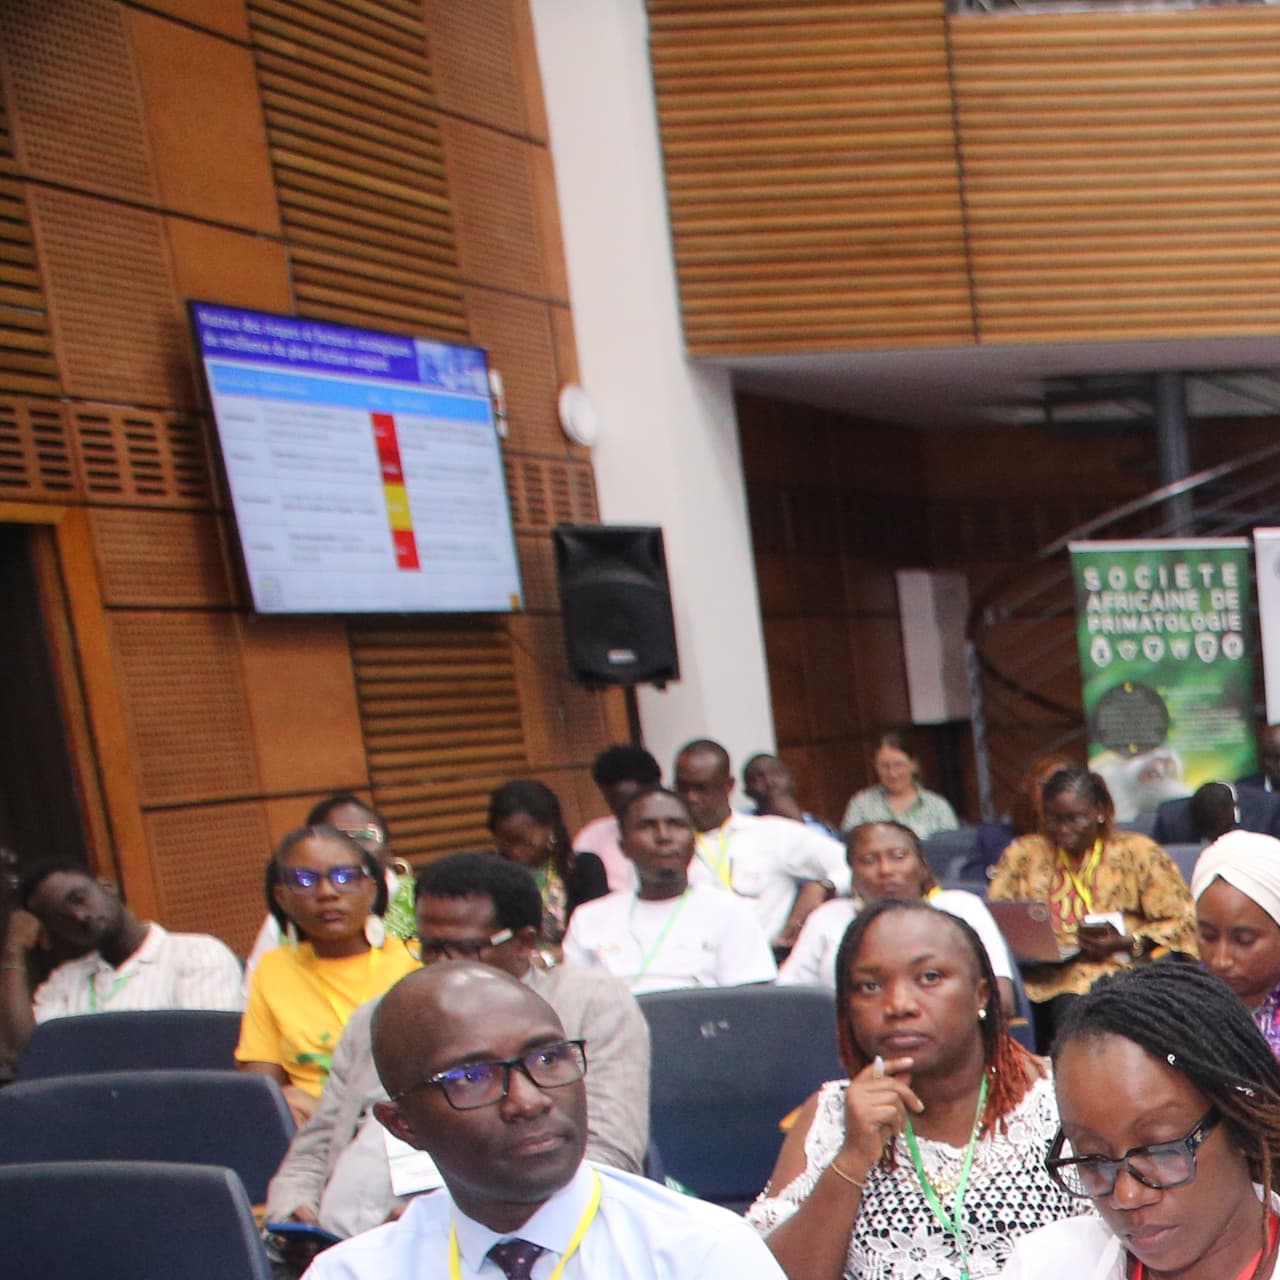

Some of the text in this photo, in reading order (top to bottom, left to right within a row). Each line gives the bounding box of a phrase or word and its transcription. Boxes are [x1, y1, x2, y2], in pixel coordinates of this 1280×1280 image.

[1084, 562, 1239, 591] SOCIETE
[1086, 588, 1240, 613] AFRICAINE DE
[1087, 610, 1242, 634] PRIMATOLOGIE
